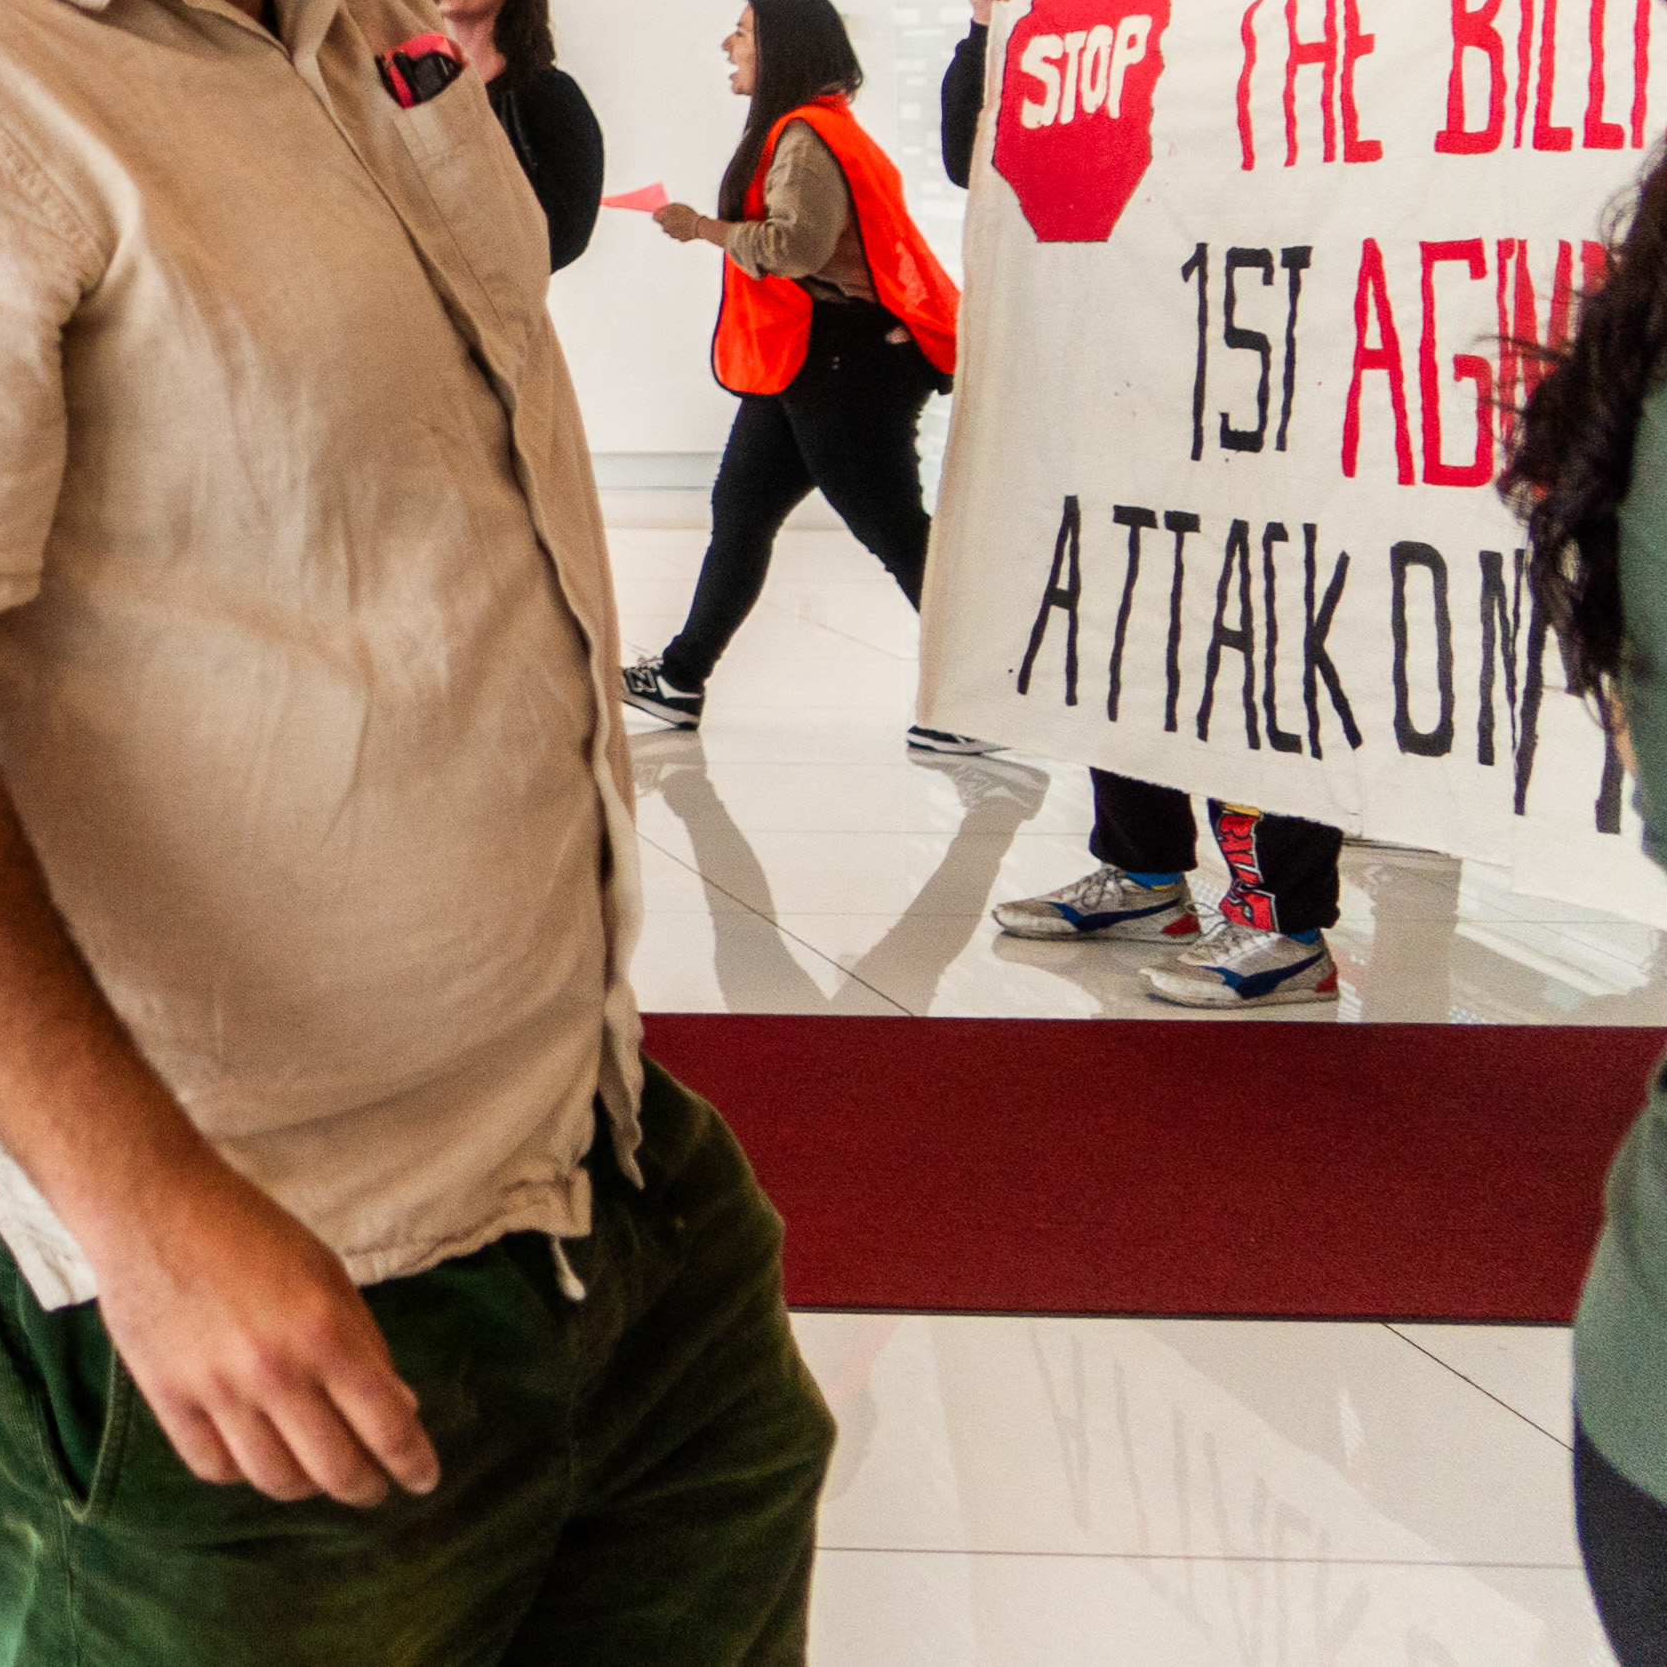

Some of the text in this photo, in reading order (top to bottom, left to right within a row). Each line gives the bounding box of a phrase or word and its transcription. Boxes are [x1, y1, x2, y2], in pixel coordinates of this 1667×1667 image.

[1019, 14, 1153, 130] STOP
[1180, 241, 1313, 462] 1ST
[1016, 494, 1364, 761] ATTACK
